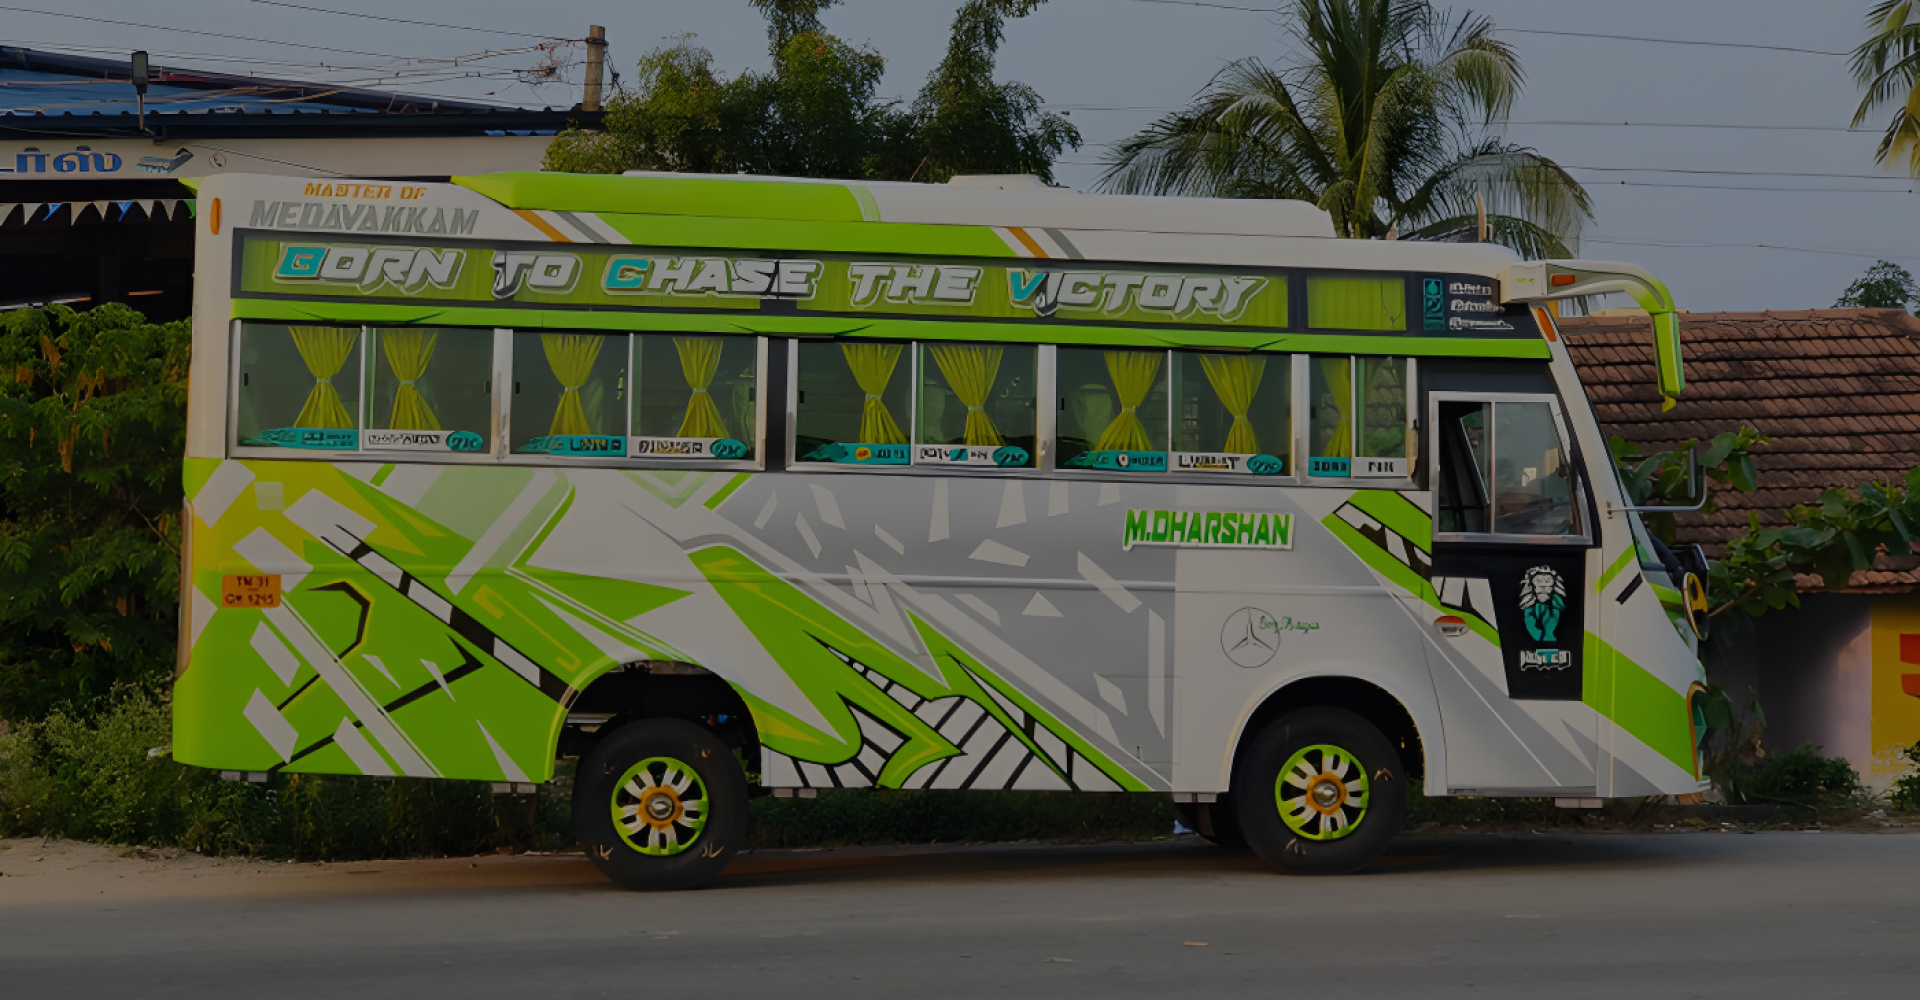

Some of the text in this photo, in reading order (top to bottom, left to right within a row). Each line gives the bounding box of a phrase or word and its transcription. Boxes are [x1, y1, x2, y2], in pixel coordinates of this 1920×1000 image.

[249, 199, 480, 235] MEDAVAKKAM
[273, 243, 1269, 323] BORN TO CHASE THE VICTORY
